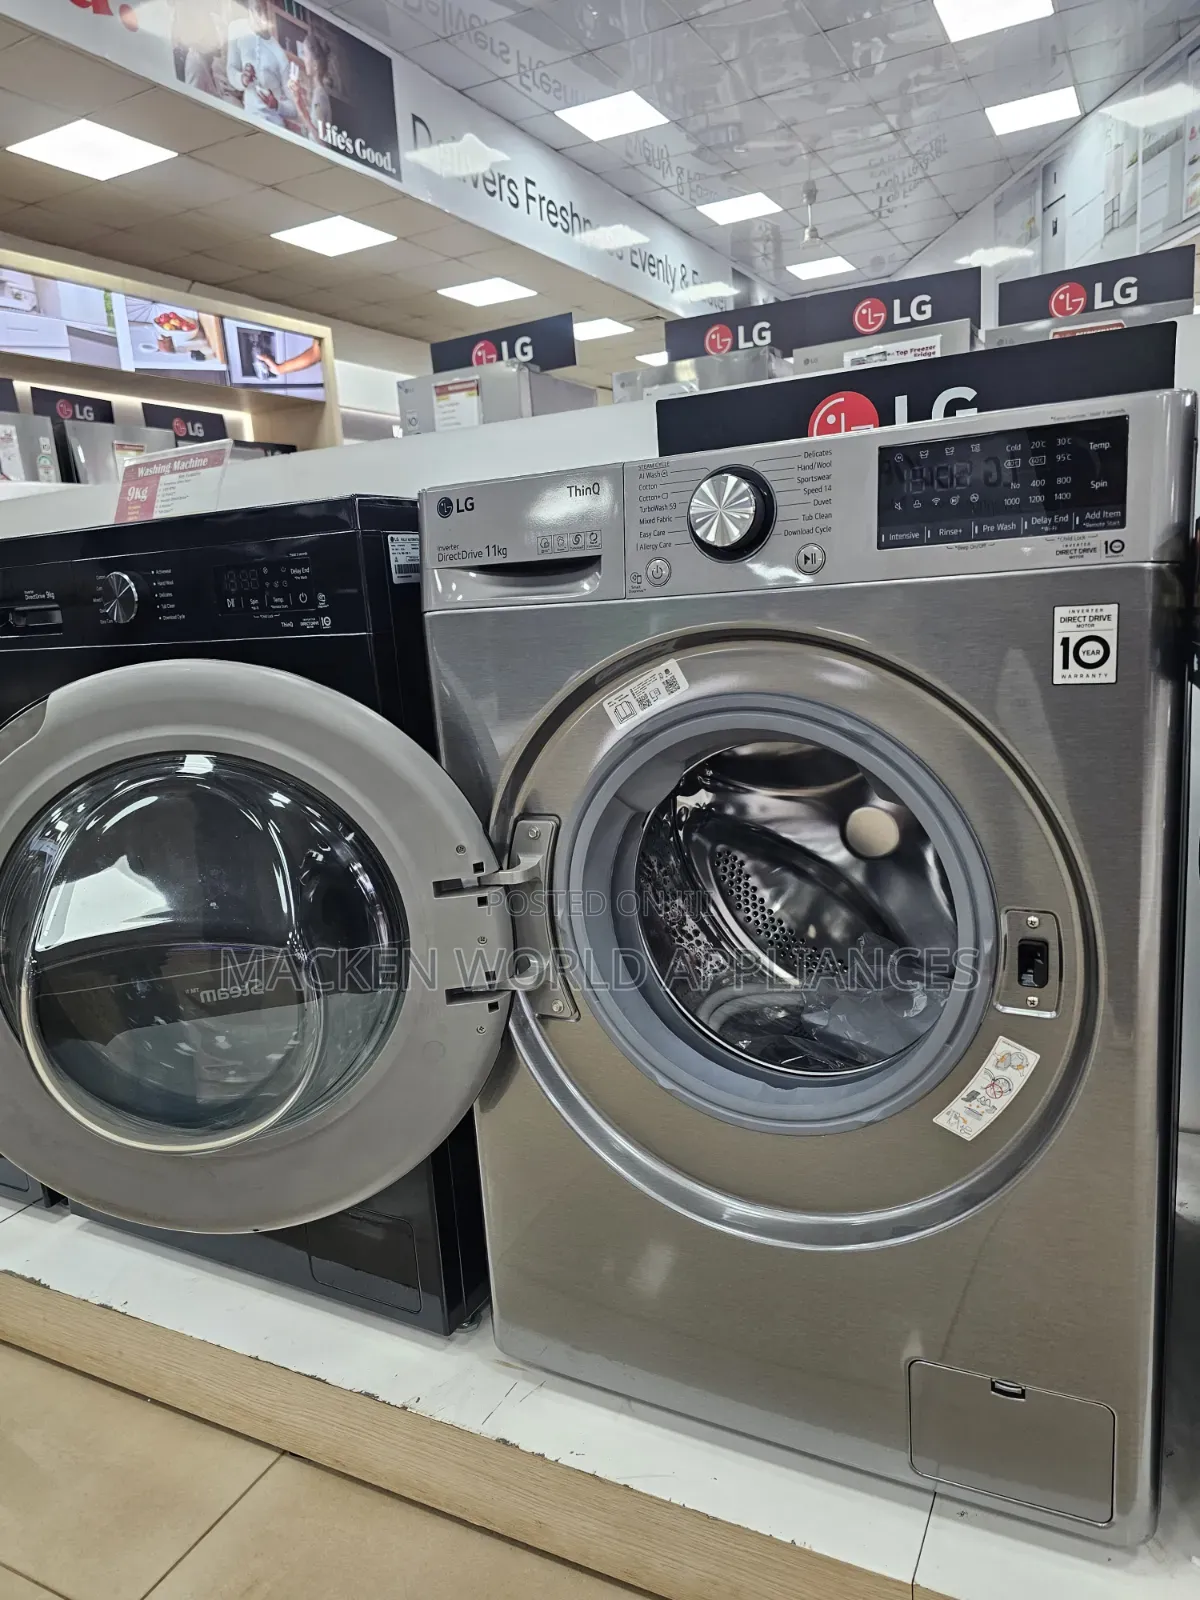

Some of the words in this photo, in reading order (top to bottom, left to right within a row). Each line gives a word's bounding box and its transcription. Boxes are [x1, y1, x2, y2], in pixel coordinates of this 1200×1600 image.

[318, 119, 354, 155] Life's
[354, 138, 397, 174] Good.
[629, 247, 677, 293] Evenly
[680, 263, 689, 290] &
[1094, 276, 1138, 310] LG
[892, 294, 932, 324] LG
[737, 321, 772, 350] LG
[501, 336, 534, 363] LG
[910, 345, 936, 354] Freezer
[75, 404, 94, 421] LG
[187, 418, 204, 438] LG
[1006, 444, 1021, 452] Cold
[1089, 442, 1111, 450] Temp.
[804, 450, 832, 459] Delicates
[138, 461, 170, 477] Washing
[173, 457, 208, 471] Machine
[797, 460, 832, 471] Hand/Wool
[646, 470, 661, 479] Wash
[797, 474, 832, 484] Sportswear
[1056, 476, 1071, 485] 800
[1090, 480, 1108, 489] Spin
[127, 487, 148, 502] 9Kg
[567, 482, 600, 498] ThinQ
[804, 486, 822, 496] Speed
[814, 498, 832, 506] Duvet
[1004, 498, 1020, 506] 1000
[1054, 492, 1071, 500] 1400
[456, 496, 475, 513] LG
[640, 504, 667, 513] TurboWash
[640, 517, 655, 525] Mixed
[657, 515, 673, 523] Fabric
[815, 512, 832, 520] Clean
[1032, 517, 1051, 525] Delay
[1054, 514, 1069, 522] End
[1085, 512, 1100, 520] Add
[1103, 510, 1121, 518] Item
[784, 527, 814, 537] Download
[815, 526, 832, 535] Cycle
[939, 528, 962, 536] Rinse+
[982, 524, 995, 532] Pre
[997, 522, 1016, 531] Wash
[640, 531, 651, 539] Easy
[889, 532, 919, 541] Intensive
[640, 543, 658, 551] Allergy
[1104, 539, 1125, 555] 10
[437, 551, 483, 563] DirectDrive
[485, 545, 508, 558] 11kg
[1088, 614, 1112, 622] DRIVE
[1060, 634, 1110, 670] 10
